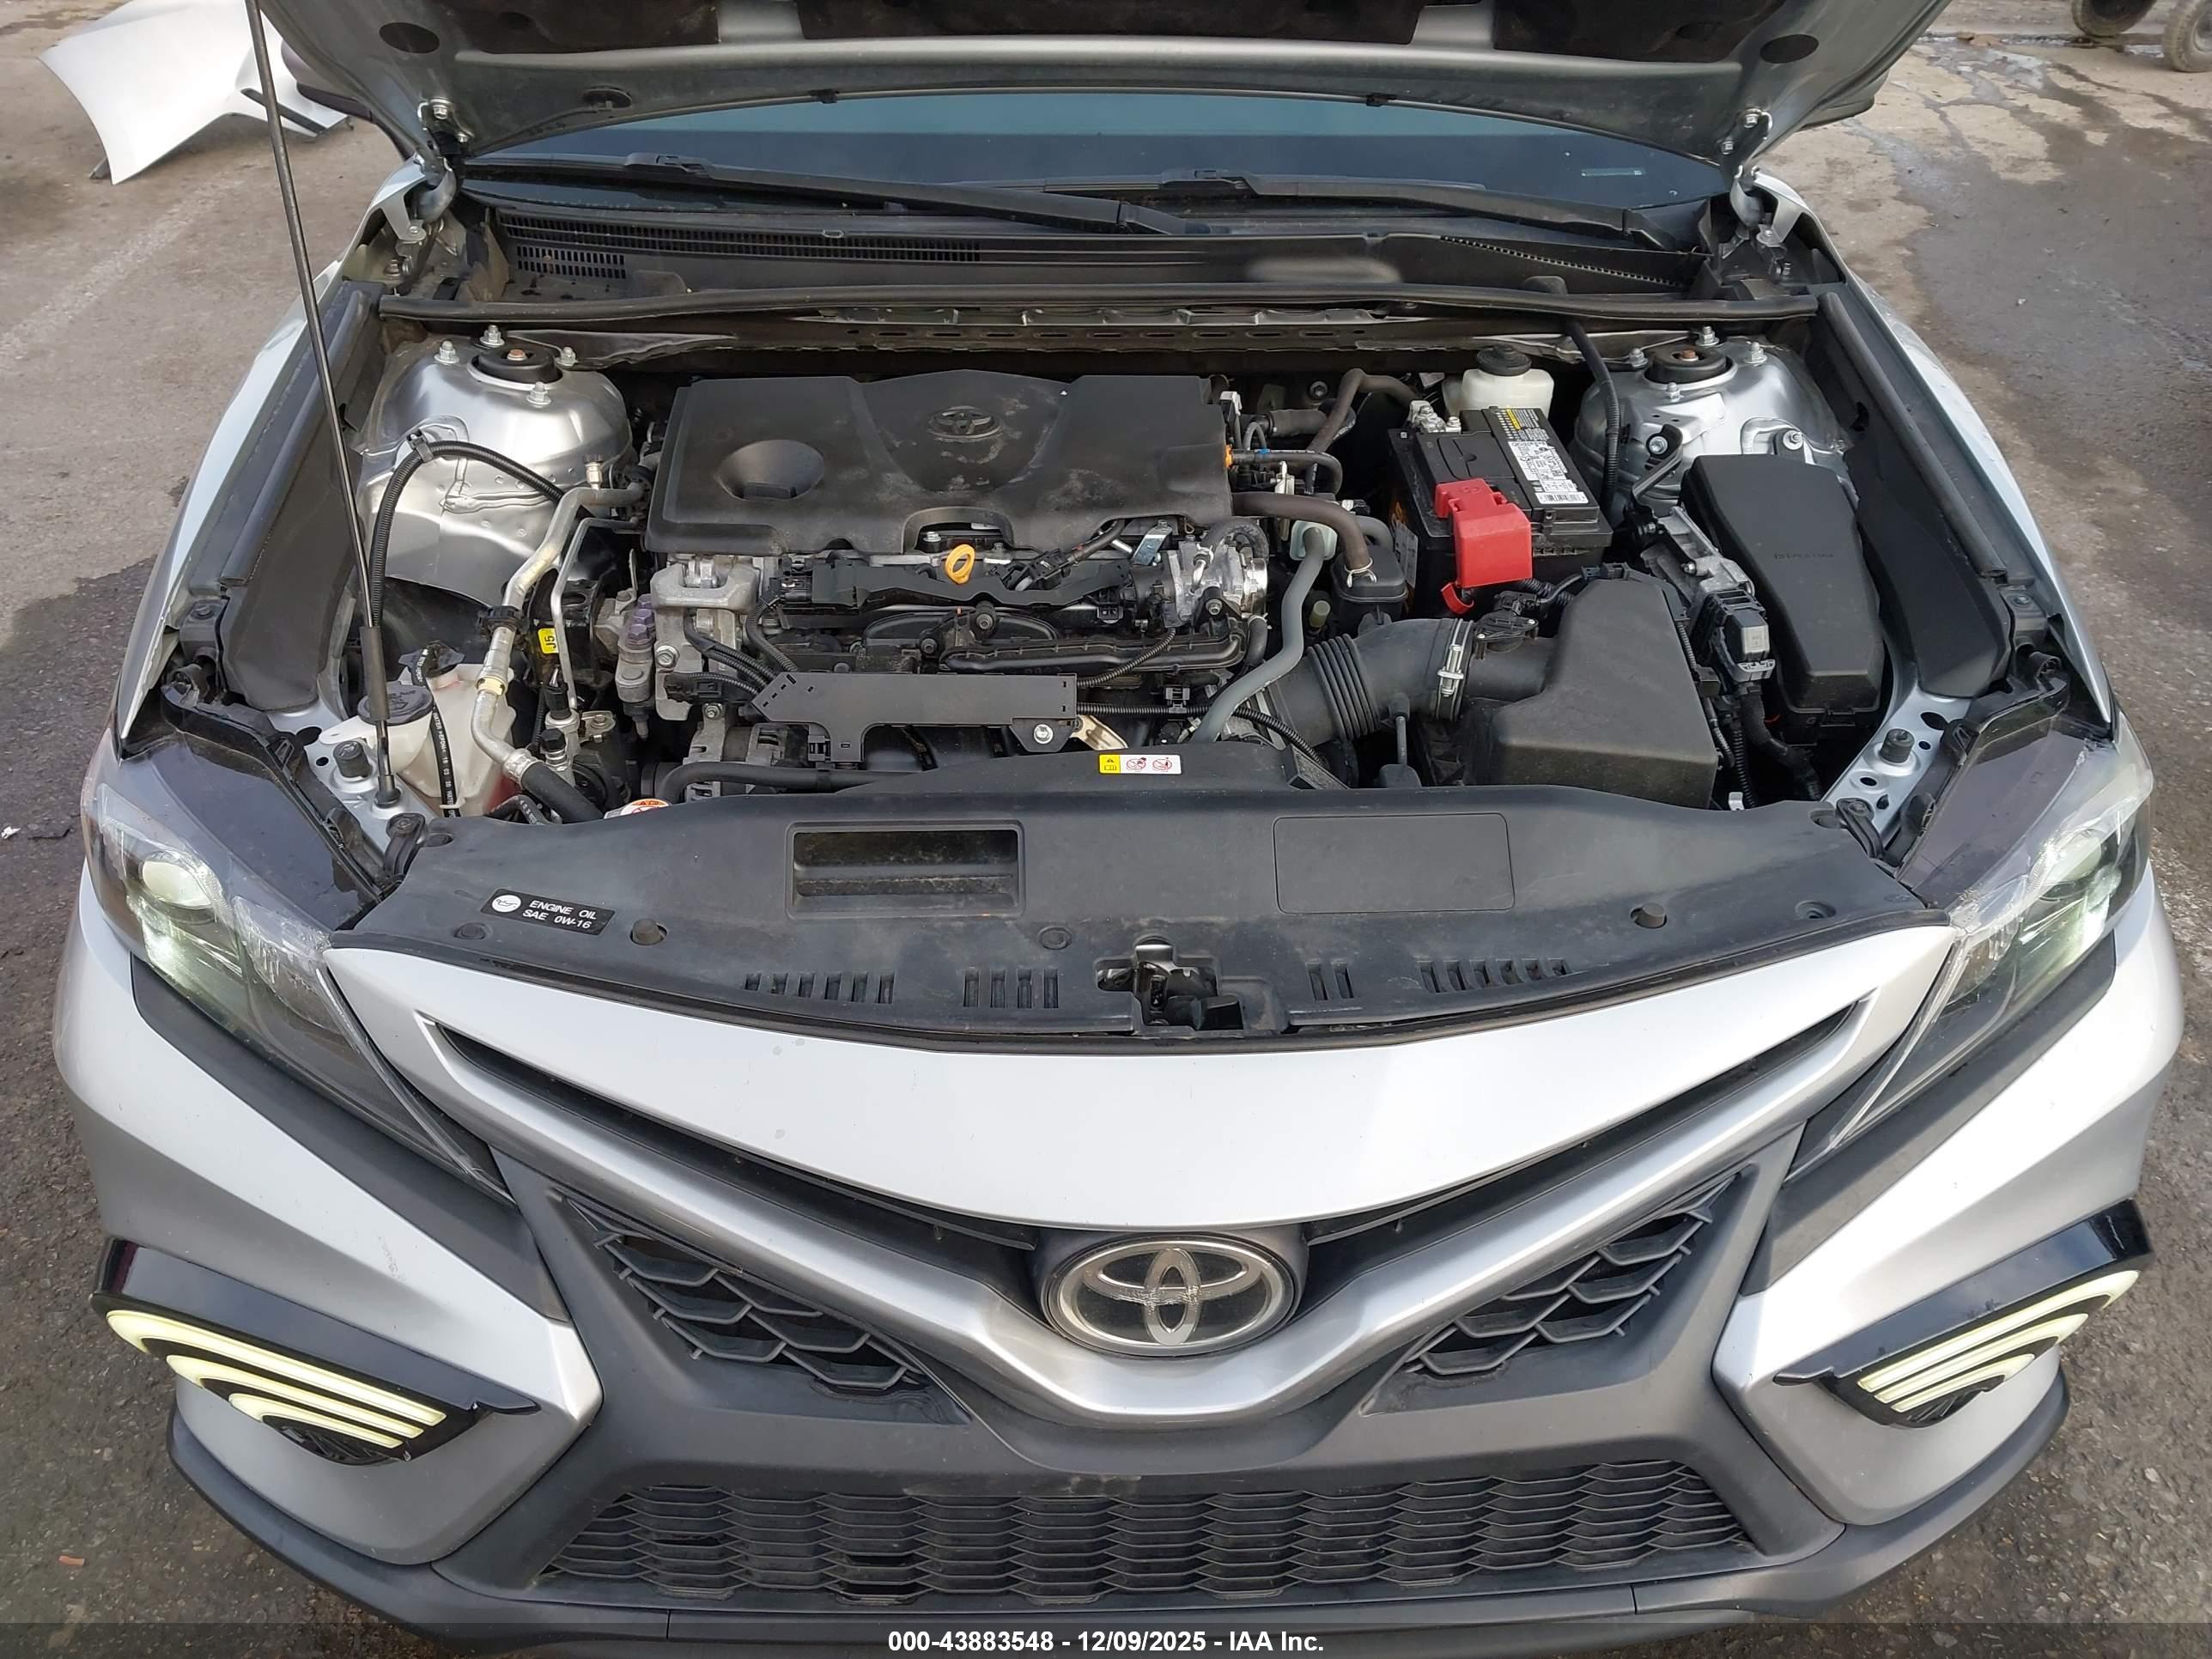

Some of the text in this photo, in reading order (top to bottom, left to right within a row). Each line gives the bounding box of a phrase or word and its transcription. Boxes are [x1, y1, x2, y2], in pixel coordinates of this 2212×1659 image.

[544, 635, 556, 649] J5
[522, 909, 592, 929] SAE 0W-16
[529, 900, 597, 920] ENGINE OIL
